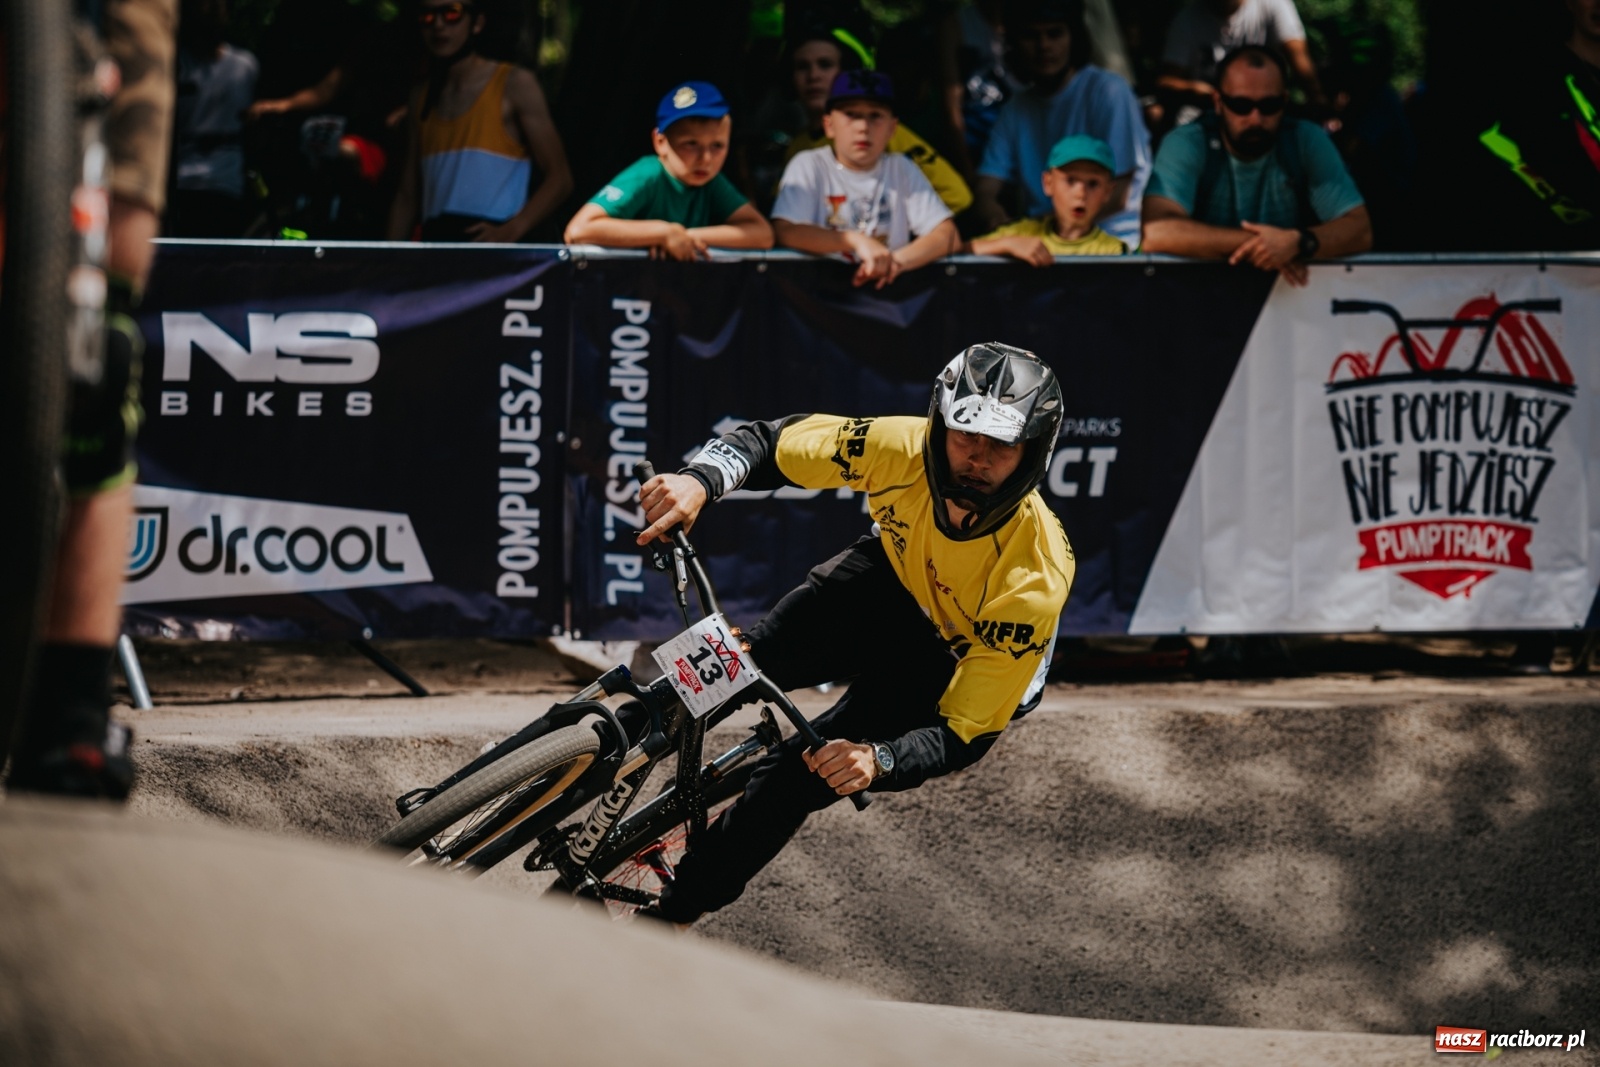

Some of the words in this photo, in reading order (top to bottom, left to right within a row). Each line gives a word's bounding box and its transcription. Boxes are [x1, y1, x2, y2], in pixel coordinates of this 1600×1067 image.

[161, 311, 380, 384] NS
[160, 391, 373, 417] BIKES
[1391, 390, 1572, 453] POMPUJESZ
[1374, 525, 1516, 564] PUMPTRACK
[686, 645, 724, 686] 13
